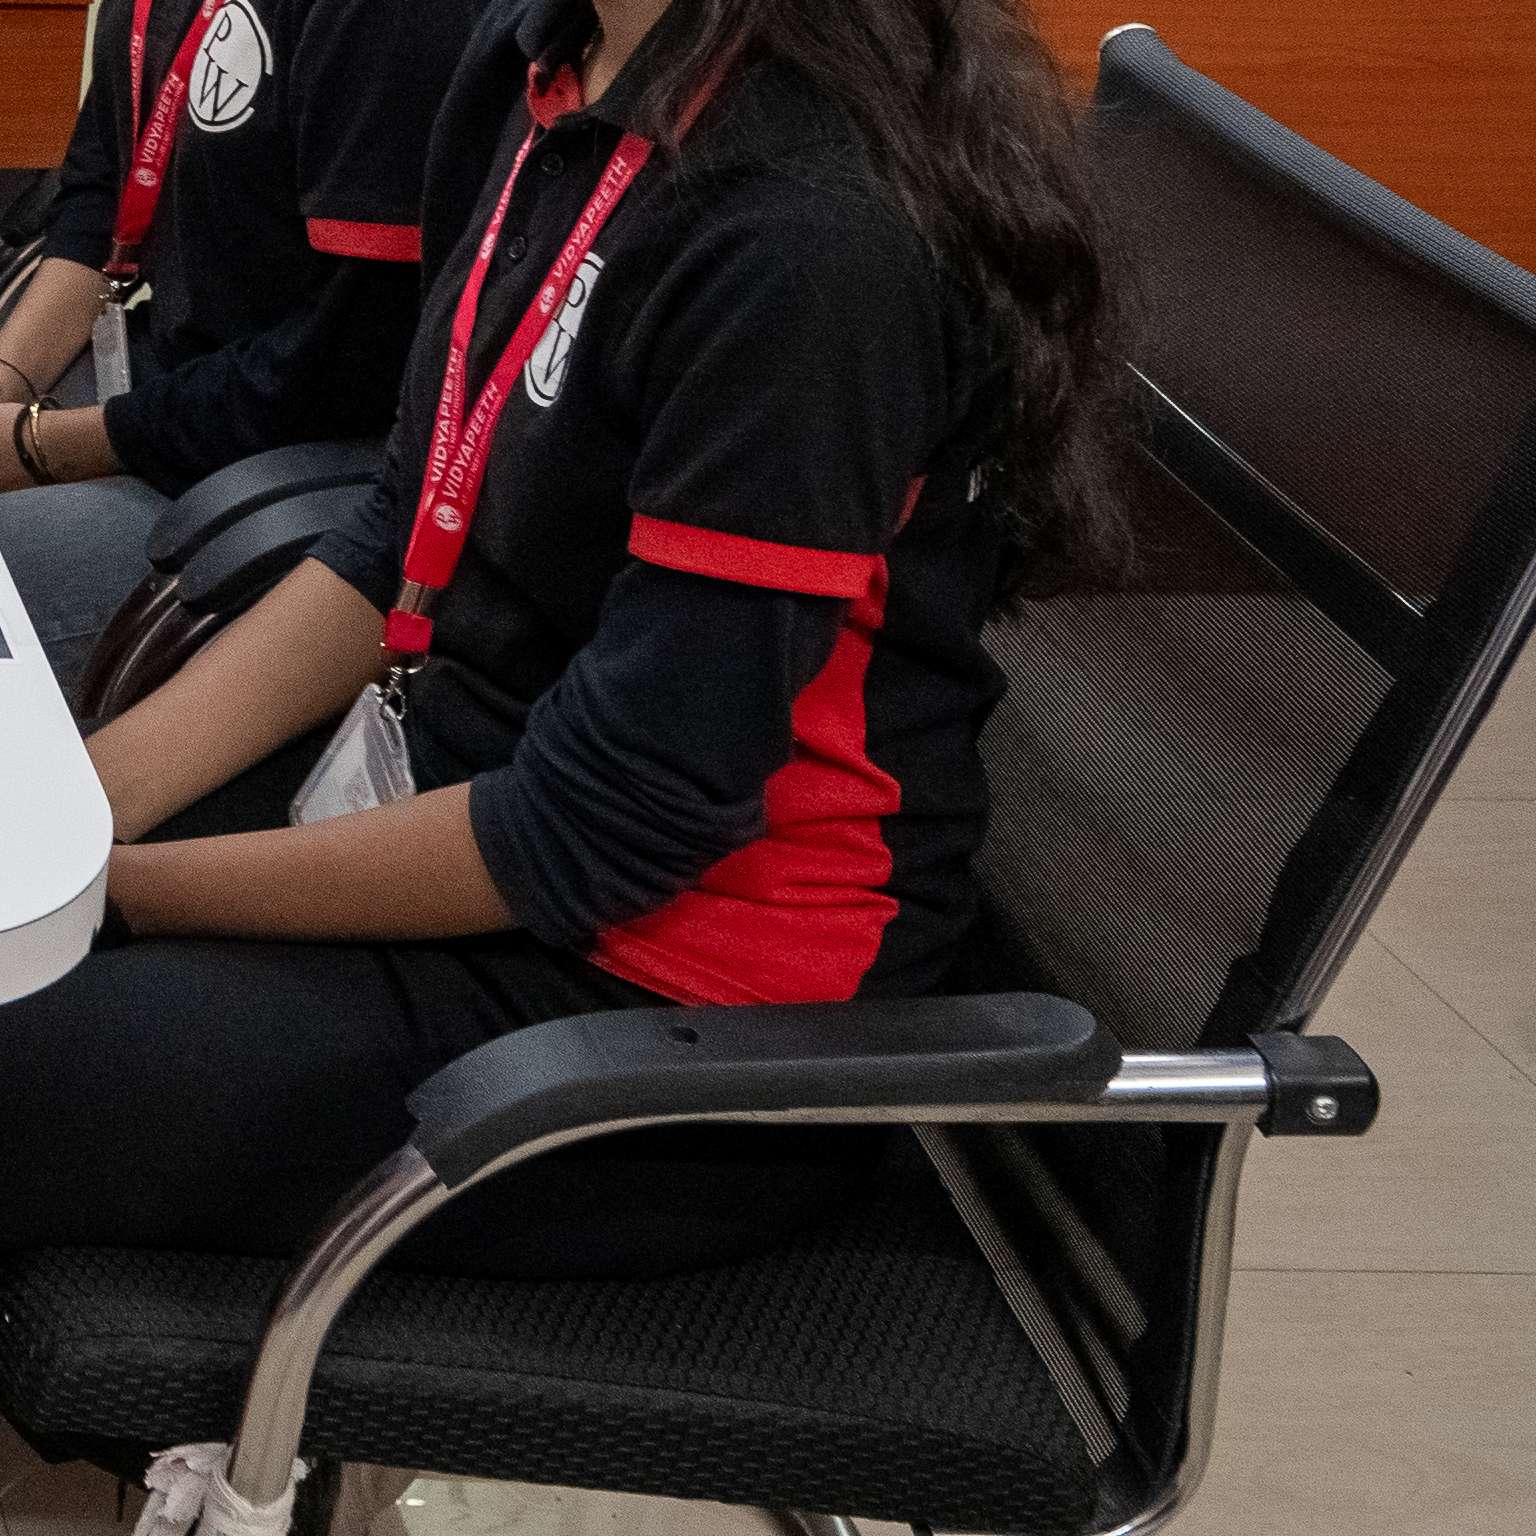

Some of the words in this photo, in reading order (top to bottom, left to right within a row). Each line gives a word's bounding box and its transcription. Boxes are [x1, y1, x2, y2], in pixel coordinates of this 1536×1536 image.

[140, 71, 183, 165] VIDYAPEETH
[196, 11, 252, 124] PW
[552, 155, 628, 280] VIDYAPEETH
[441, 381, 501, 500] VIDYAPEETH
